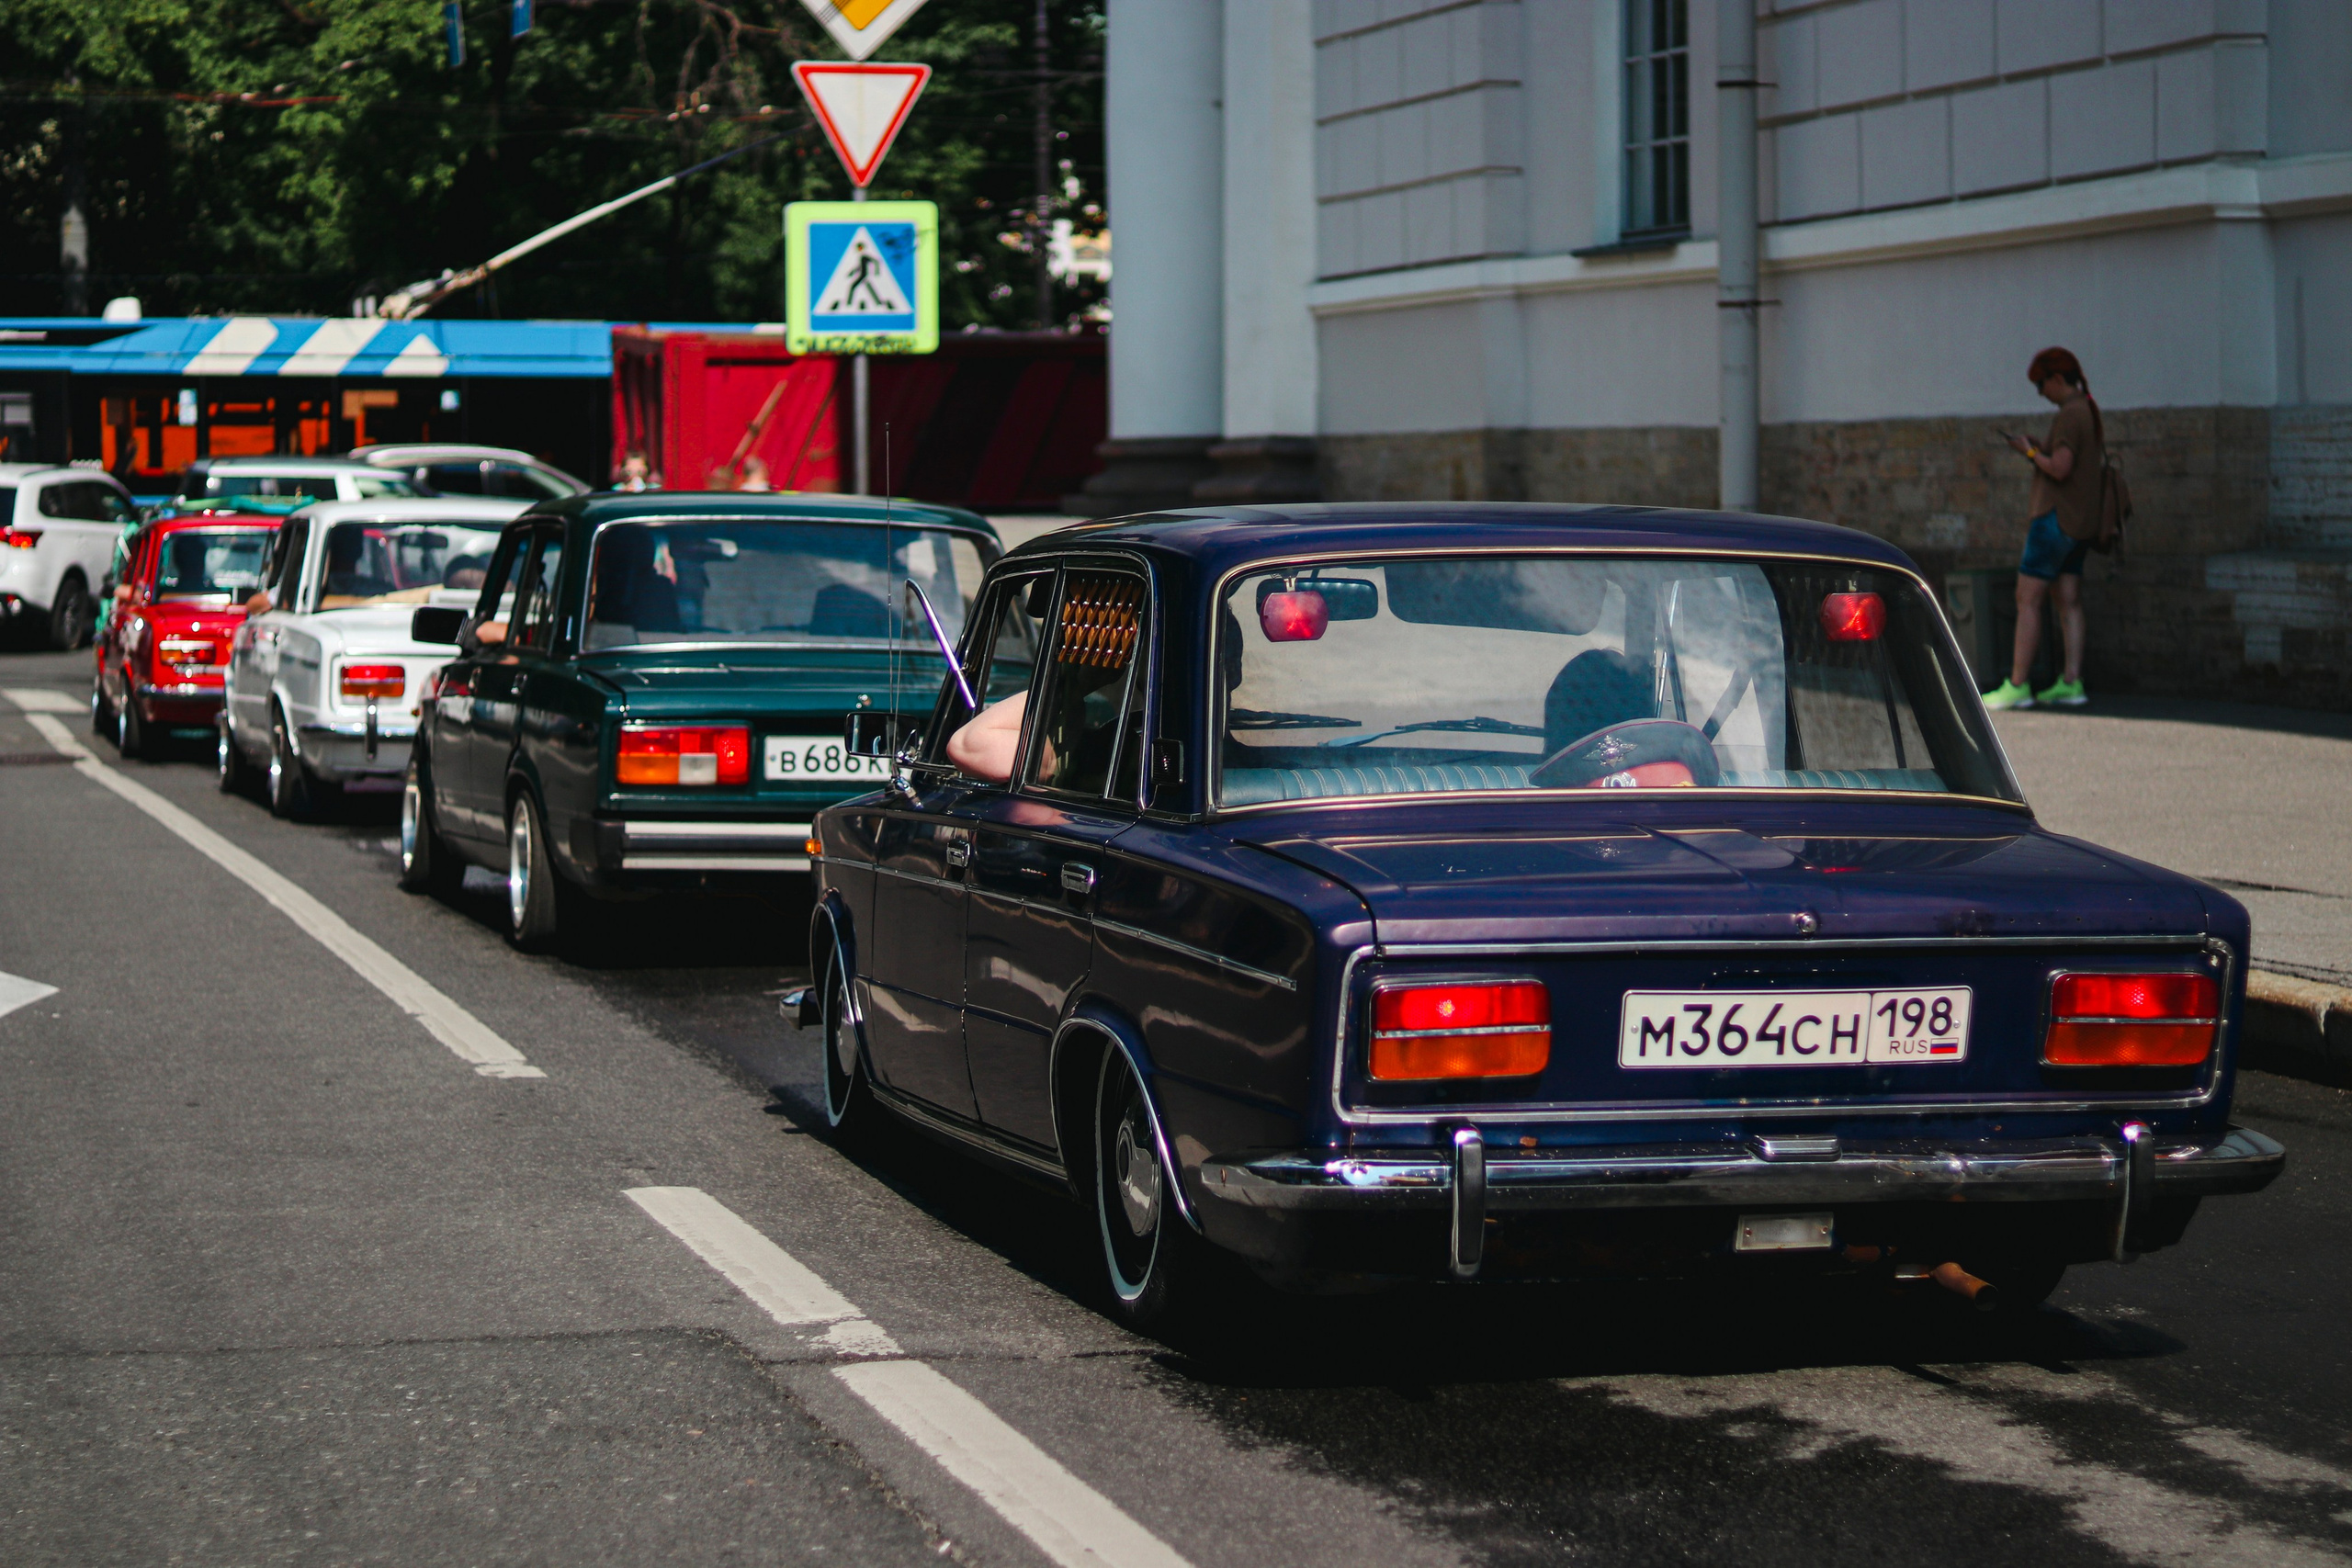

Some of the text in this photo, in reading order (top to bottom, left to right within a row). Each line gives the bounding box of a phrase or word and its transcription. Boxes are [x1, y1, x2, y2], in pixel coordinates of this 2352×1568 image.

[1639, 996, 1954, 1057] М364СН 198
[1889, 1039, 1928, 1055] RUS
